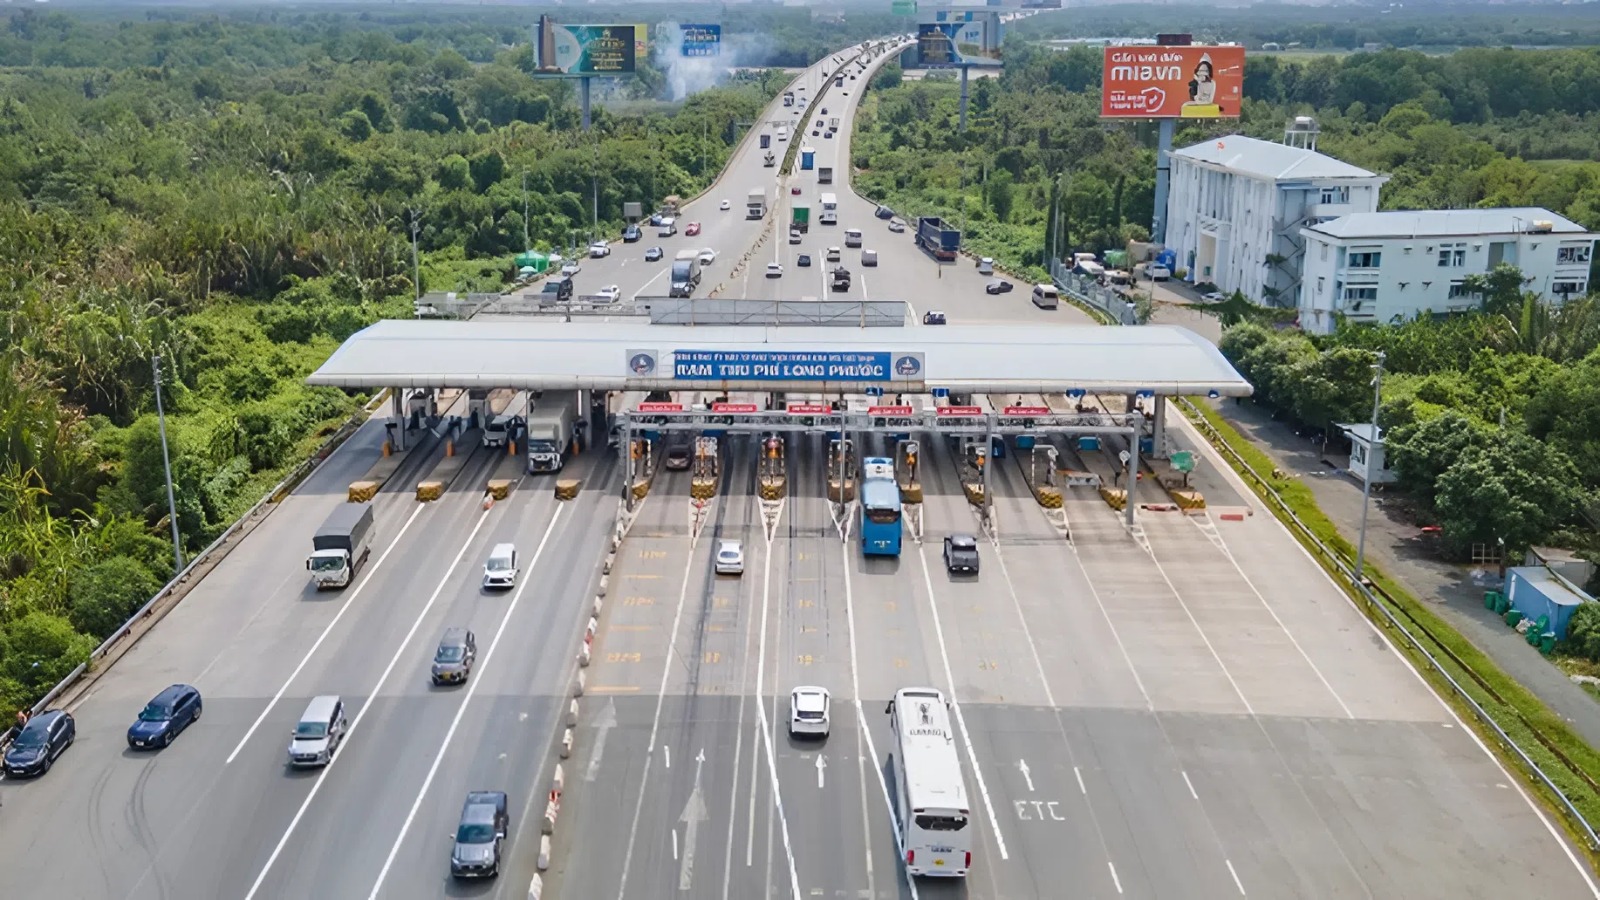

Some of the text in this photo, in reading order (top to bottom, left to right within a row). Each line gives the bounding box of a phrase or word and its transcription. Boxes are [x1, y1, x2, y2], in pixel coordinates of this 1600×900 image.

[1111, 65, 1182, 81] mia.vn
[783, 364, 825, 377] LONG
[1012, 799, 1066, 820] ETC
